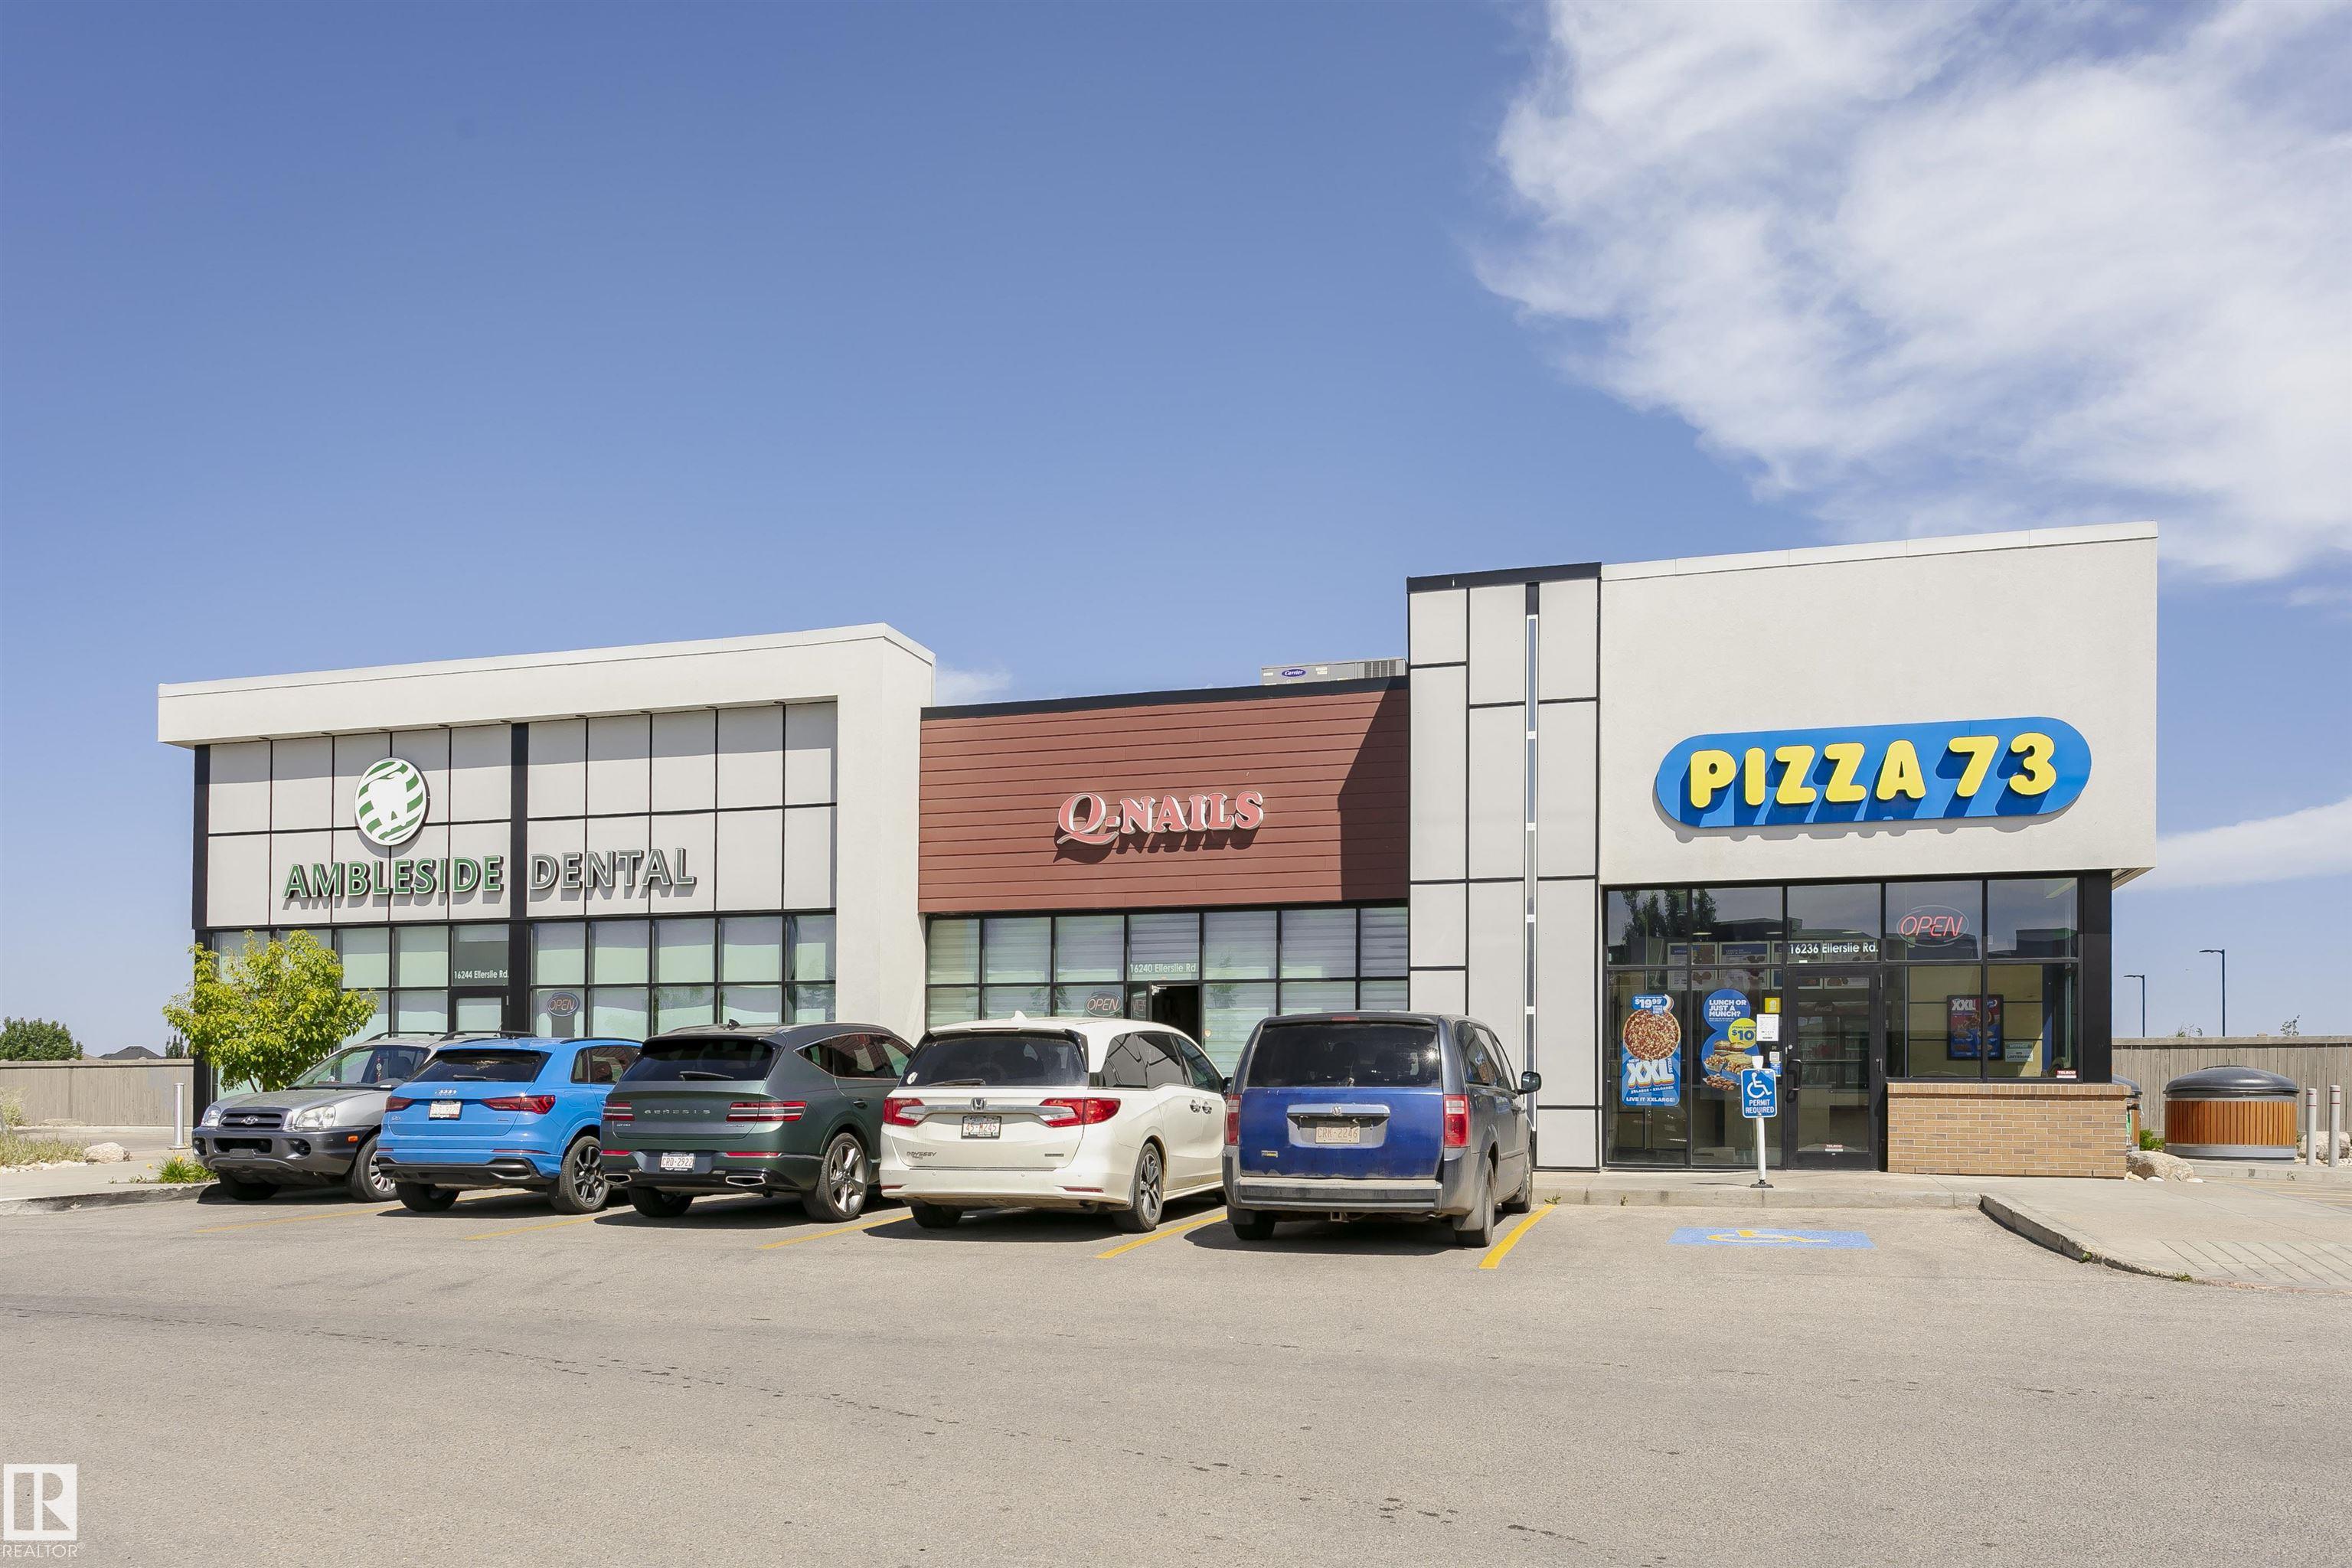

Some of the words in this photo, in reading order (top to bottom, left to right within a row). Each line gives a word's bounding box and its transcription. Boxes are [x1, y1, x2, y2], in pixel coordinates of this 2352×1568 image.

[1690, 739, 1926, 808] PIZZA
[1949, 732, 2056, 798] 73
[1057, 791, 1263, 844] Q-NAILS
[283, 855, 504, 898] AMBLESIDE
[530, 848, 697, 890] DENTAL
[1900, 915, 1964, 937] OPEN
[1789, 943, 1819, 955] 16236
[1821, 942, 1860, 954] Ellerslie
[1862, 942, 1879, 953] Rd.
[454, 971, 473, 979] 16244
[474, 970, 498, 978] Ellerslie
[1130, 964, 1153, 973] 16240
[1155, 963, 1184, 972] Ellerslie
[550, 999, 575, 1011] OPEN
[1086, 998, 1119, 1011] OPEN
[1626, 1059, 1675, 1089] XXL
